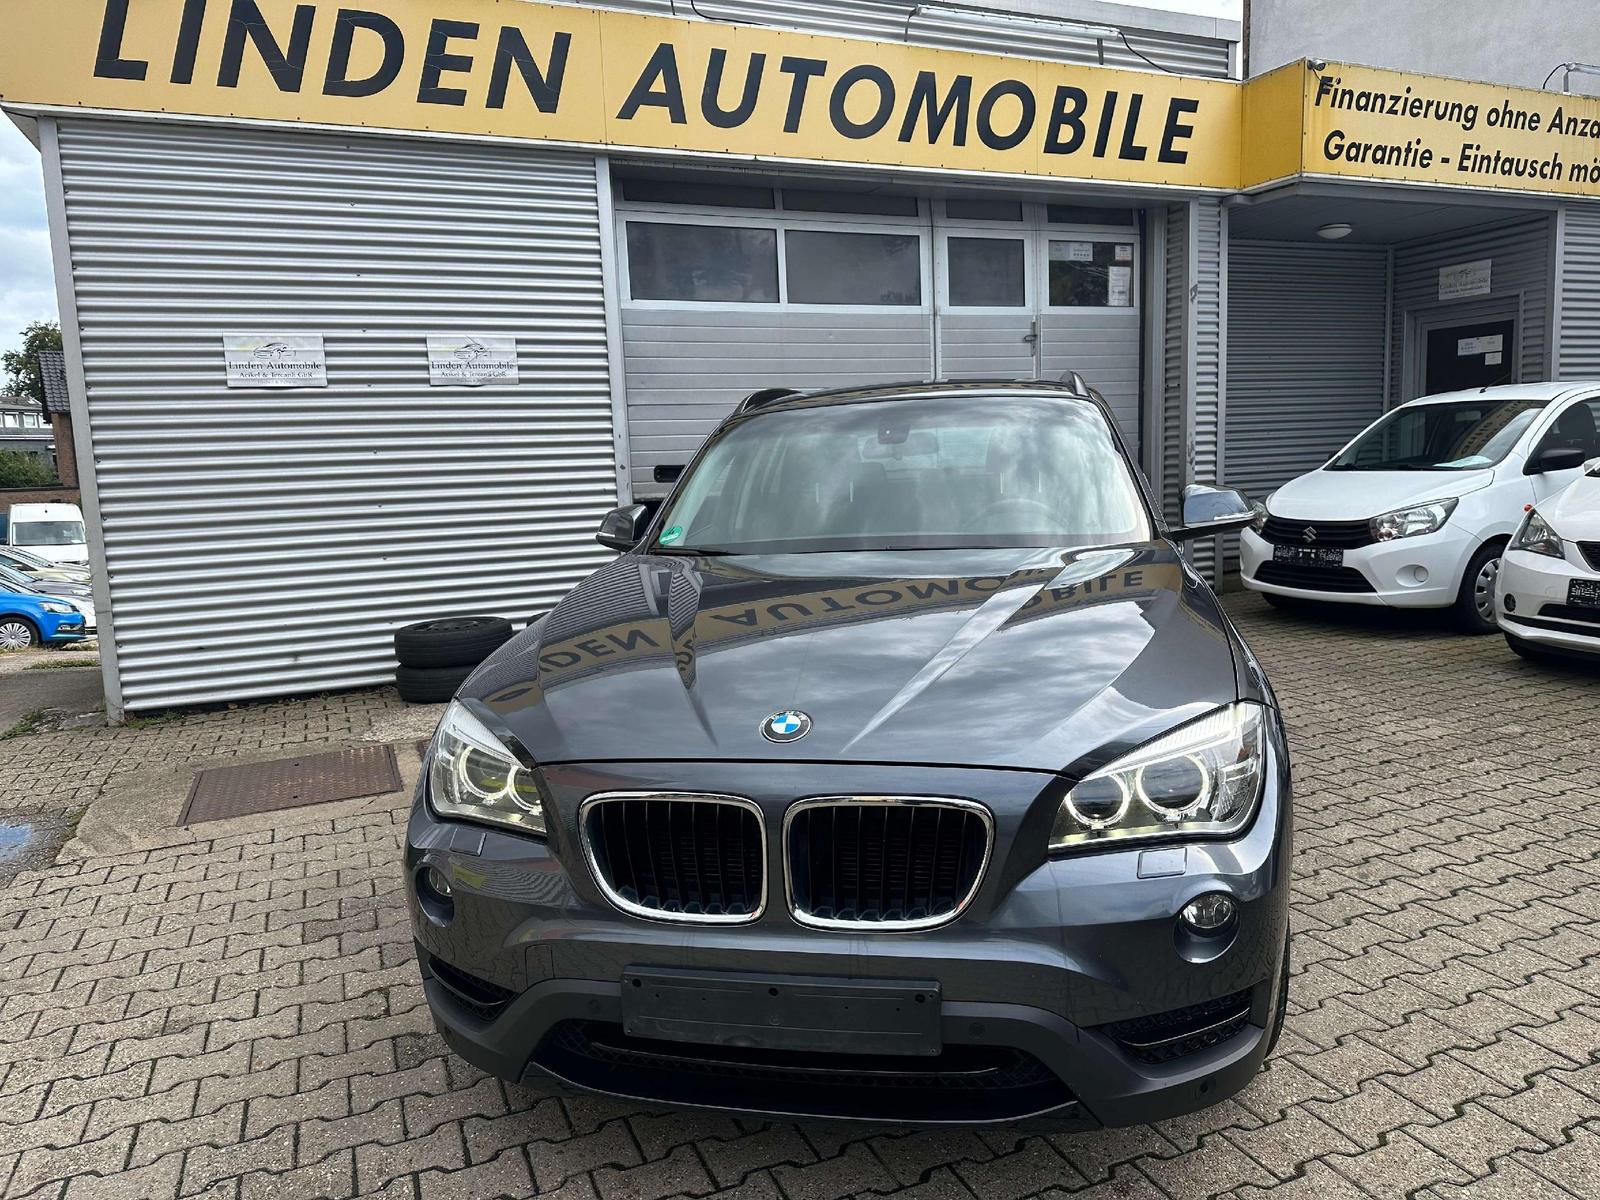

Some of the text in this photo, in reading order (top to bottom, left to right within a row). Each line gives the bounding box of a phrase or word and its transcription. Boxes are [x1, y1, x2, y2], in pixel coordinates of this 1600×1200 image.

[94, 0, 1199, 165] LINDEN AUTOMOBILE
[1314, 75, 1479, 131] Finanzierung
[1486, 99, 1541, 131] ohne
[1323, 129, 1433, 169] Garantie
[1457, 143, 1563, 180] Eintausch
[228, 361, 322, 370] Linden Automobile
[431, 361, 515, 370] Linden Automobile
